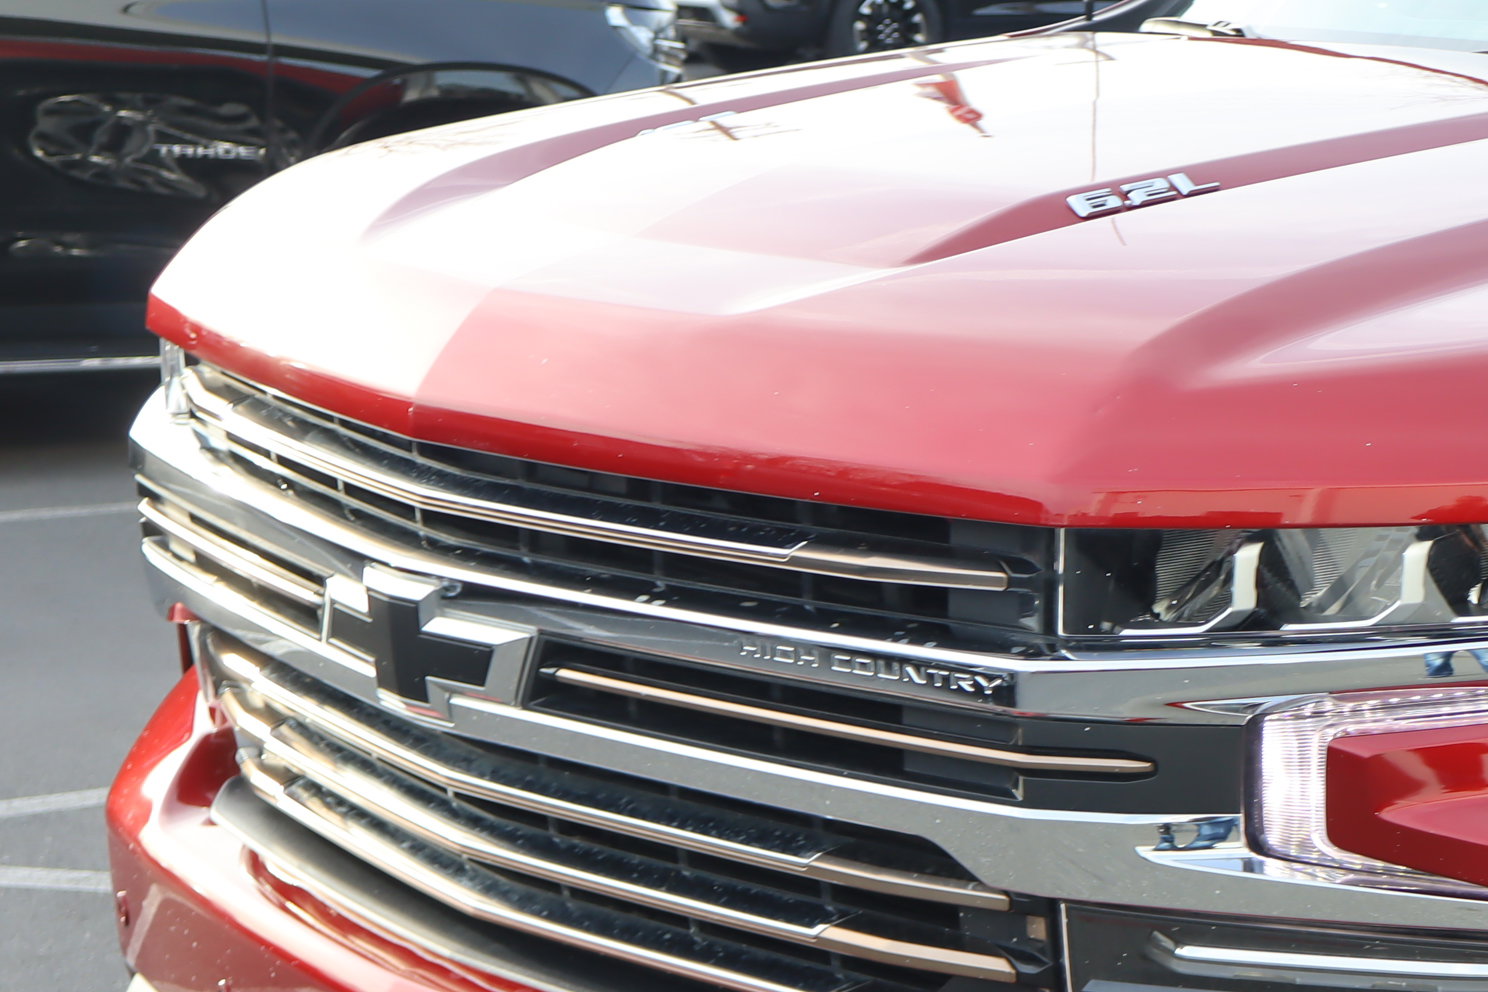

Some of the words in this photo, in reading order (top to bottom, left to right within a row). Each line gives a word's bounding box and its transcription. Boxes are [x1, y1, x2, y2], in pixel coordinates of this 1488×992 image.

[151, 143, 258, 161] TAHOE
[738, 639, 819, 668] HIGH
[830, 652, 1003, 695] COUNTRY
